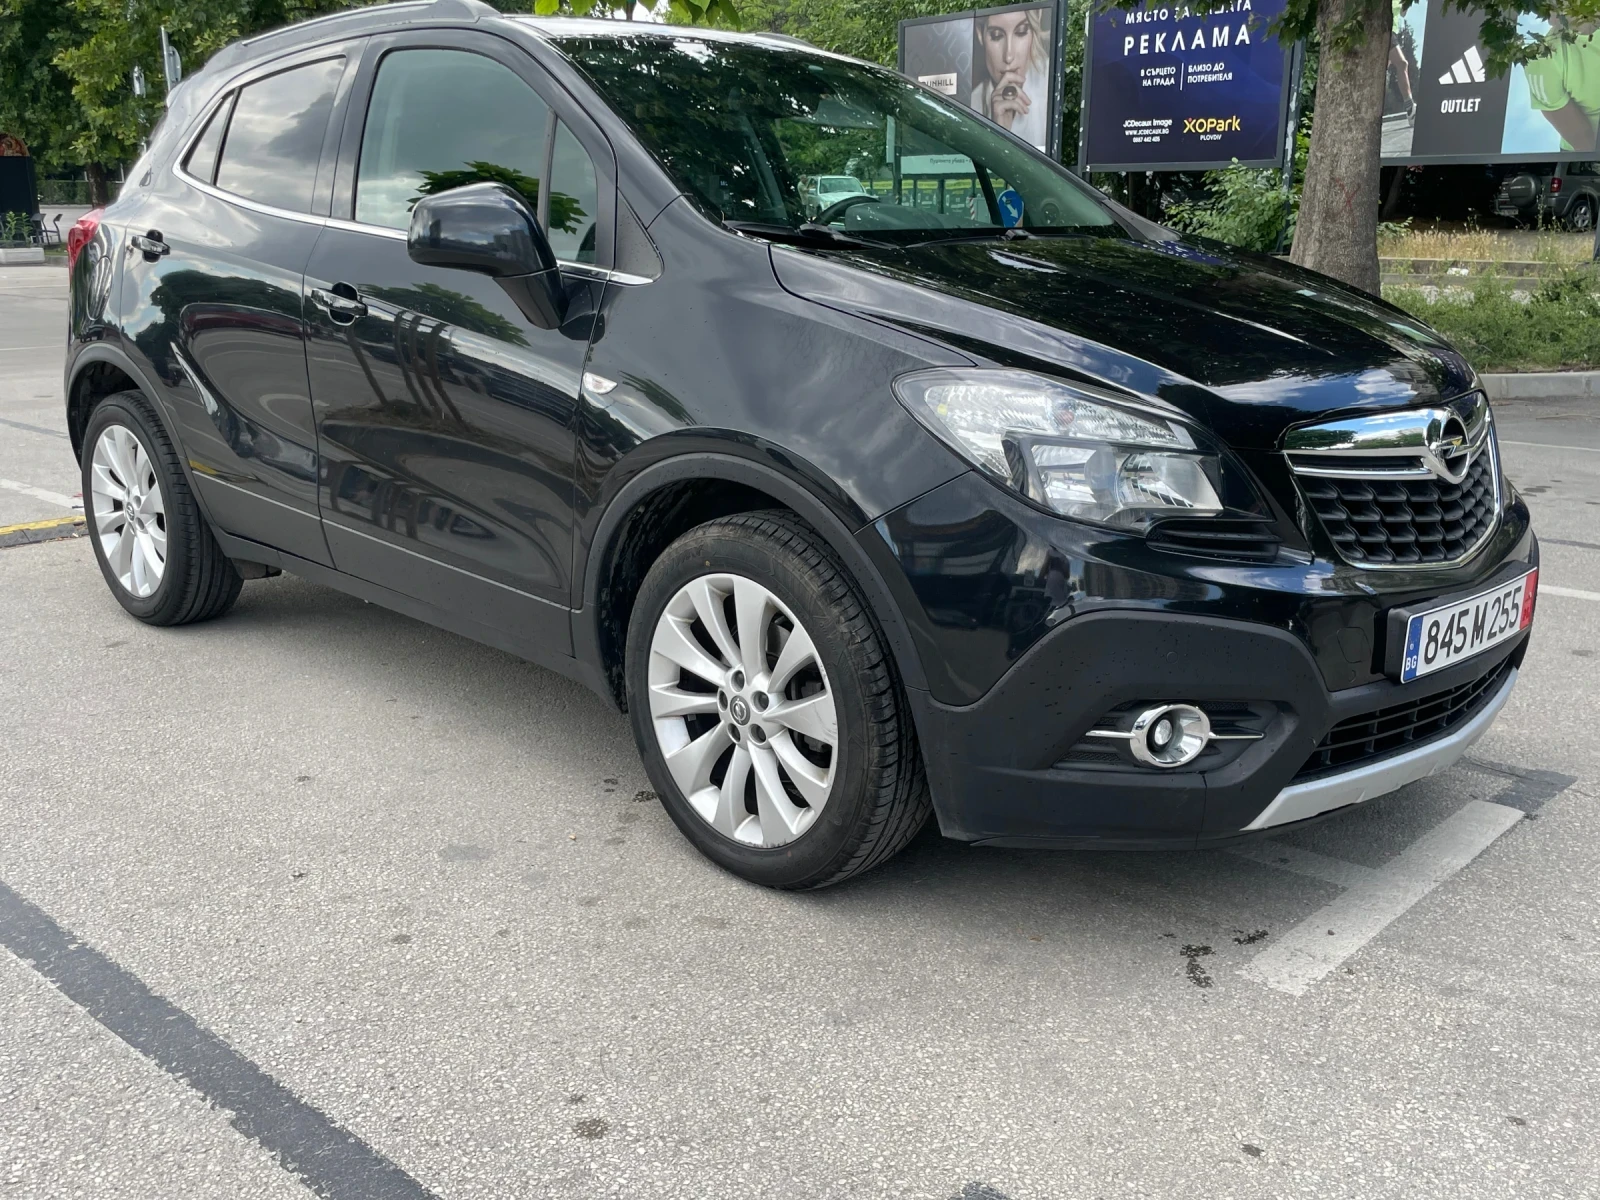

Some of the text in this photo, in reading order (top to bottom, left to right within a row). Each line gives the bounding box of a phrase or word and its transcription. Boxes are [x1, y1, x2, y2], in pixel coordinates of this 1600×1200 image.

[1125, 8, 1169, 25] МЯСТО
[1123, 24, 1251, 56] РЕКЛАМА
[1140, 66, 1176, 77] В СЪРЦЕТО
[1188, 62, 1225, 73] БЛИЗО ДО
[922, 79, 954, 88] UNHILL
[1142, 76, 1175, 87] НА ГРАДА
[1187, 72, 1233, 84] ПОТРЕБИТЕЛЯ
[1440, 98, 1481, 114] OUTLET
[1123, 118, 1173, 128] JCDecaux Image
[1200, 133, 1222, 141] PLOVDIV
[1405, 656, 1418, 671] BG
